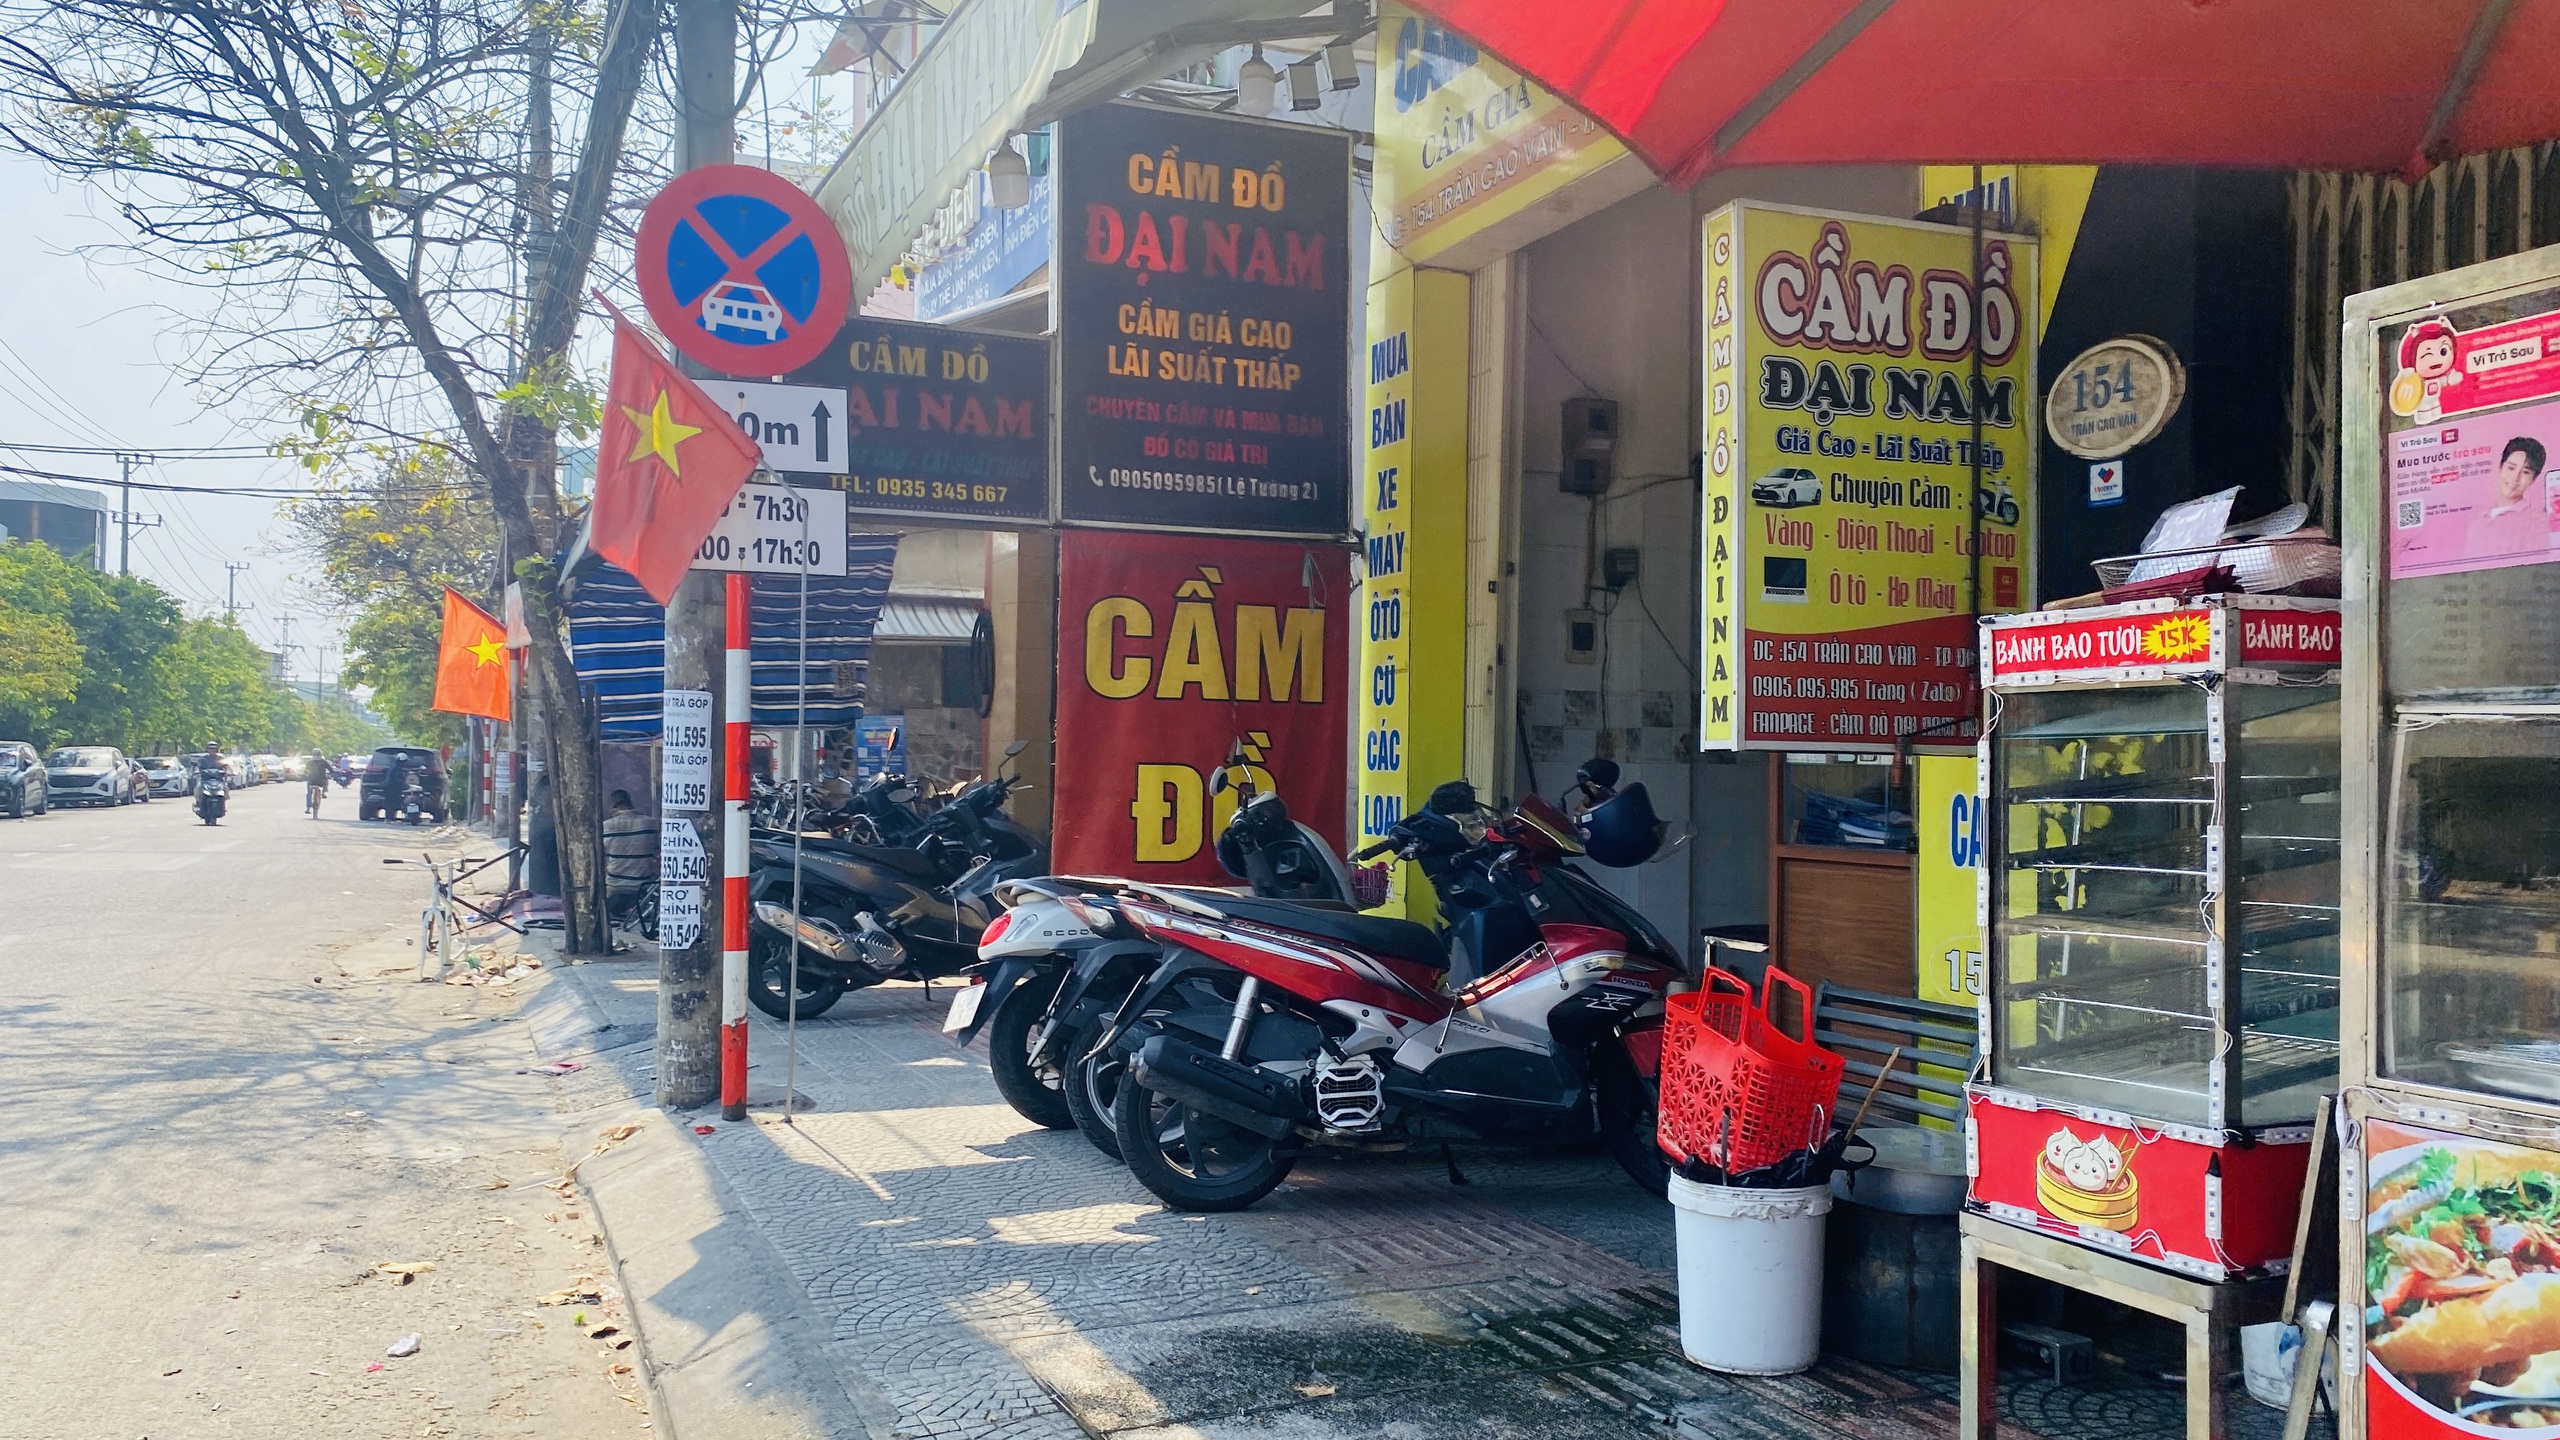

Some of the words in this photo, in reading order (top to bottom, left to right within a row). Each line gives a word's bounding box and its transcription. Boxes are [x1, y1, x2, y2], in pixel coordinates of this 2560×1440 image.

[1128, 145, 1220, 203] CẦM
[1232, 160, 1286, 212] ĐỒ
[1480, 147, 1521, 191] CAO
[1085, 204, 1189, 287] ĐẠI
[1204, 220, 1327, 291] NAM
[1758, 225, 1912, 353] CẦM
[1922, 244, 2019, 362] ĐỒ
[1118, 297, 1180, 339] CẦM
[1189, 310, 1233, 345] GIÁ
[1241, 318, 1292, 350] CAO
[850, 334, 927, 377] CẦM
[942, 342, 989, 383] ĐỒ
[1108, 342, 1149, 377] LÃI
[1159, 346, 1226, 384] SUẤT
[1234, 351, 1301, 390] THẤP
[1371, 331, 1408, 386] MUA
[2487, 349, 2507, 363] Trả
[2510, 346, 2534, 359] Sau
[1760, 356, 1875, 425] ĐẠI
[1884, 366, 2018, 428] NAM
[2072, 358, 2135, 412] 154
[728, 411, 799, 445] 0m
[849, 381, 900, 438] ẠI
[918, 388, 1033, 439] NAM
[1371, 392, 1406, 449] BÁN
[2098, 416, 2116, 432] CAO
[1776, 426, 1811, 453] Giá
[1817, 433, 1856, 457] Cao
[1876, 435, 1903, 462] Lãi
[1909, 440, 1954, 465] Suất
[2397, 457, 2419, 468] Mua
[877, 477, 925, 498] 0935
[932, 482, 967, 501] 345
[973, 485, 1007, 502] 667
[1377, 467, 1398, 511] XE
[1831, 472, 1903, 509] Chuyên
[1909, 475, 1951, 509] Cầm
[752, 537, 821, 566] 17h30
[1369, 522, 1405, 578] MÁY
[1765, 512, 1813, 551] Vàng
[1837, 518, 1878, 555] Điện
[1884, 520, 1934, 558] Thoại
[1830, 568, 1841, 605] Ô
[1848, 574, 1867, 606] tô
[1916, 577, 1956, 614] Máy
[1085, 566, 1325, 703] CẦM
[1753, 639, 1774, 661] ĐC
[1812, 637, 1851, 664] TRẦN
[1855, 643, 1883, 665] CAO
[1996, 633, 2046, 665] BÁNH
[2051, 631, 2092, 660] BAO
[2097, 625, 2141, 657] TƯƠI
[2159, 625, 2199, 648] 15K
[2245, 619, 2293, 648] BÁNH
[2298, 624, 2333, 651] BAO
[1373, 655, 1395, 706] CŨ
[1711, 615, 1729, 723] NAM
[1752, 675, 1859, 699] 0905.095.985
[1864, 679, 1905, 704] Trang
[672, 695, 686, 708] TRẢ
[688, 696, 709, 709] GÓP
[1752, 711, 1816, 734] FANPAGE
[1830, 708, 1864, 735] CẦM
[1869, 709, 1889, 736] ĐỒ
[672, 752, 685, 765] TRẢ
[687, 753, 708, 766] GÓP
[1367, 719, 1400, 771] CÁC
[1613, 976, 1652, 989] HONDA
[1945, 948, 1983, 996] 15
